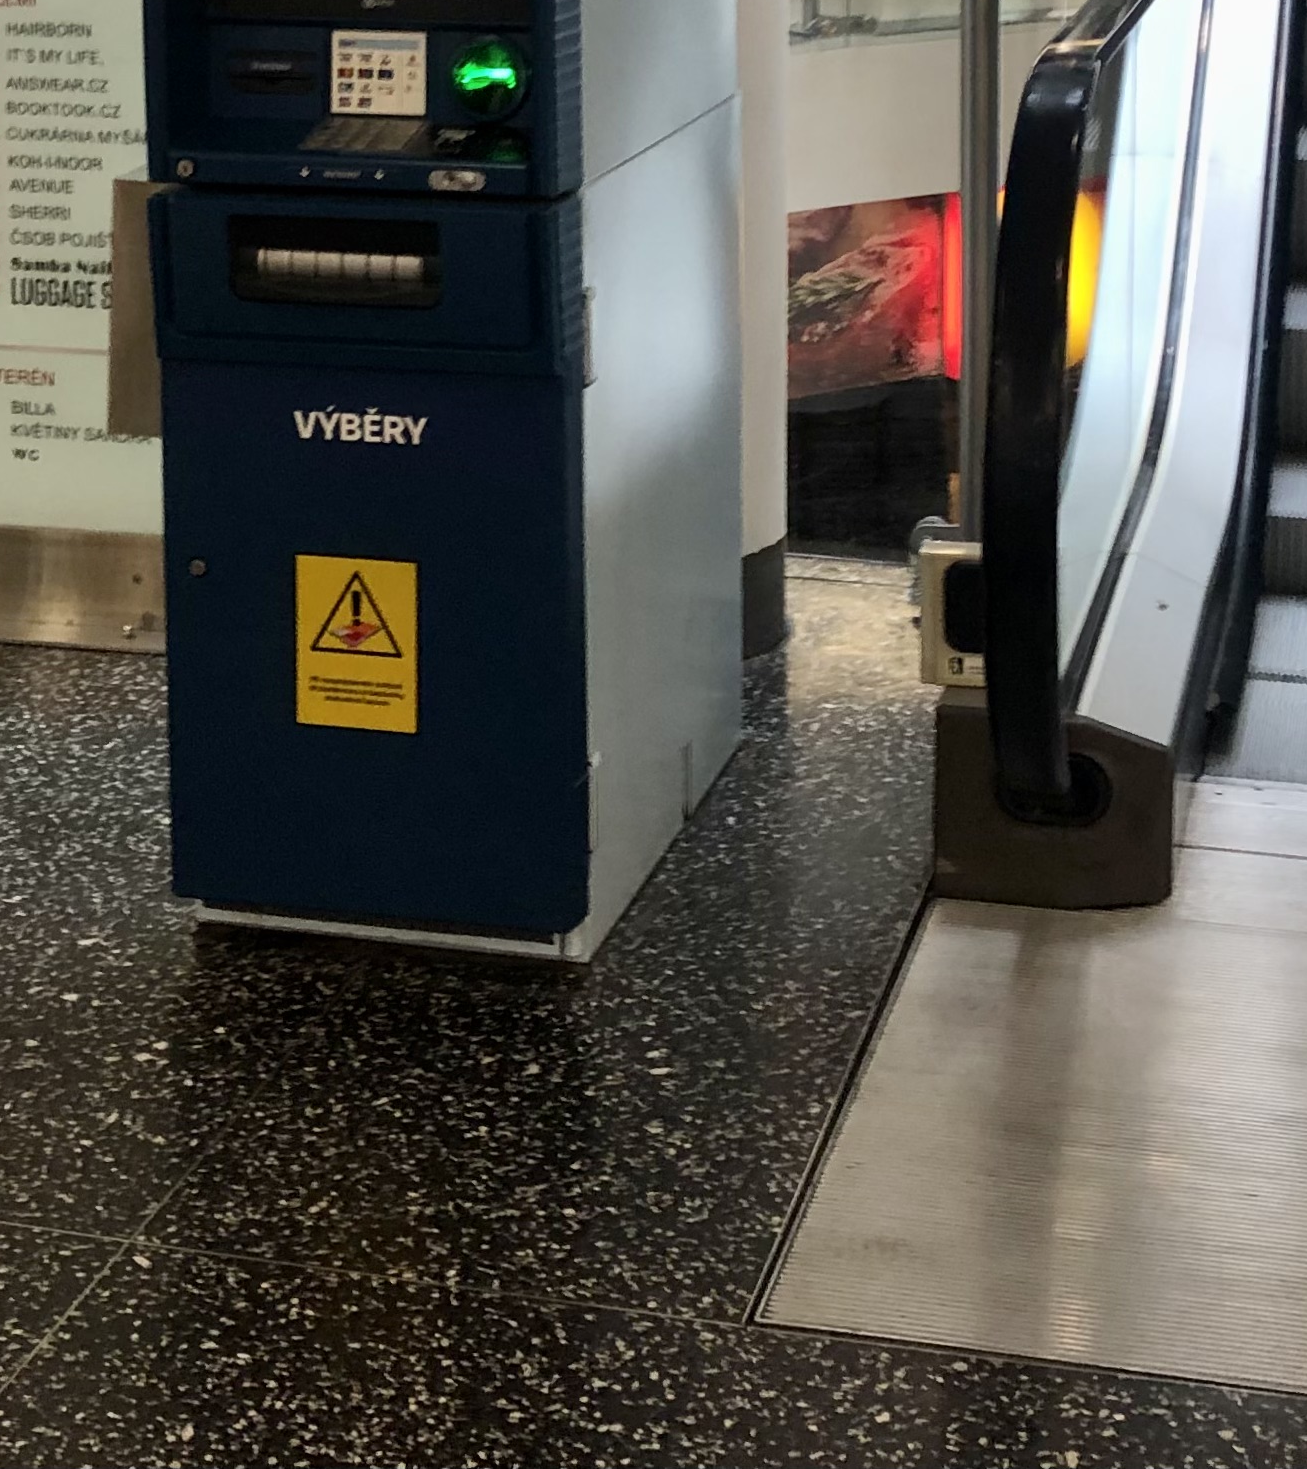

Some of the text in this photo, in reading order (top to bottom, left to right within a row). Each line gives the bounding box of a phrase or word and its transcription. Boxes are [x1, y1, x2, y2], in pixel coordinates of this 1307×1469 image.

[5, 22, 93, 38] HAIRBORN
[6, 48, 36, 64] IT'S
[39, 49, 64, 64] MY
[8, 179, 75, 195] AVENUE
[10, 257, 72, 273] Samba
[10, 277, 97, 309] LUGGAGE
[10, 400, 56, 416] BILLA
[293, 405, 429, 445] VÝBĚRY
[11, 448, 40, 462] WC
